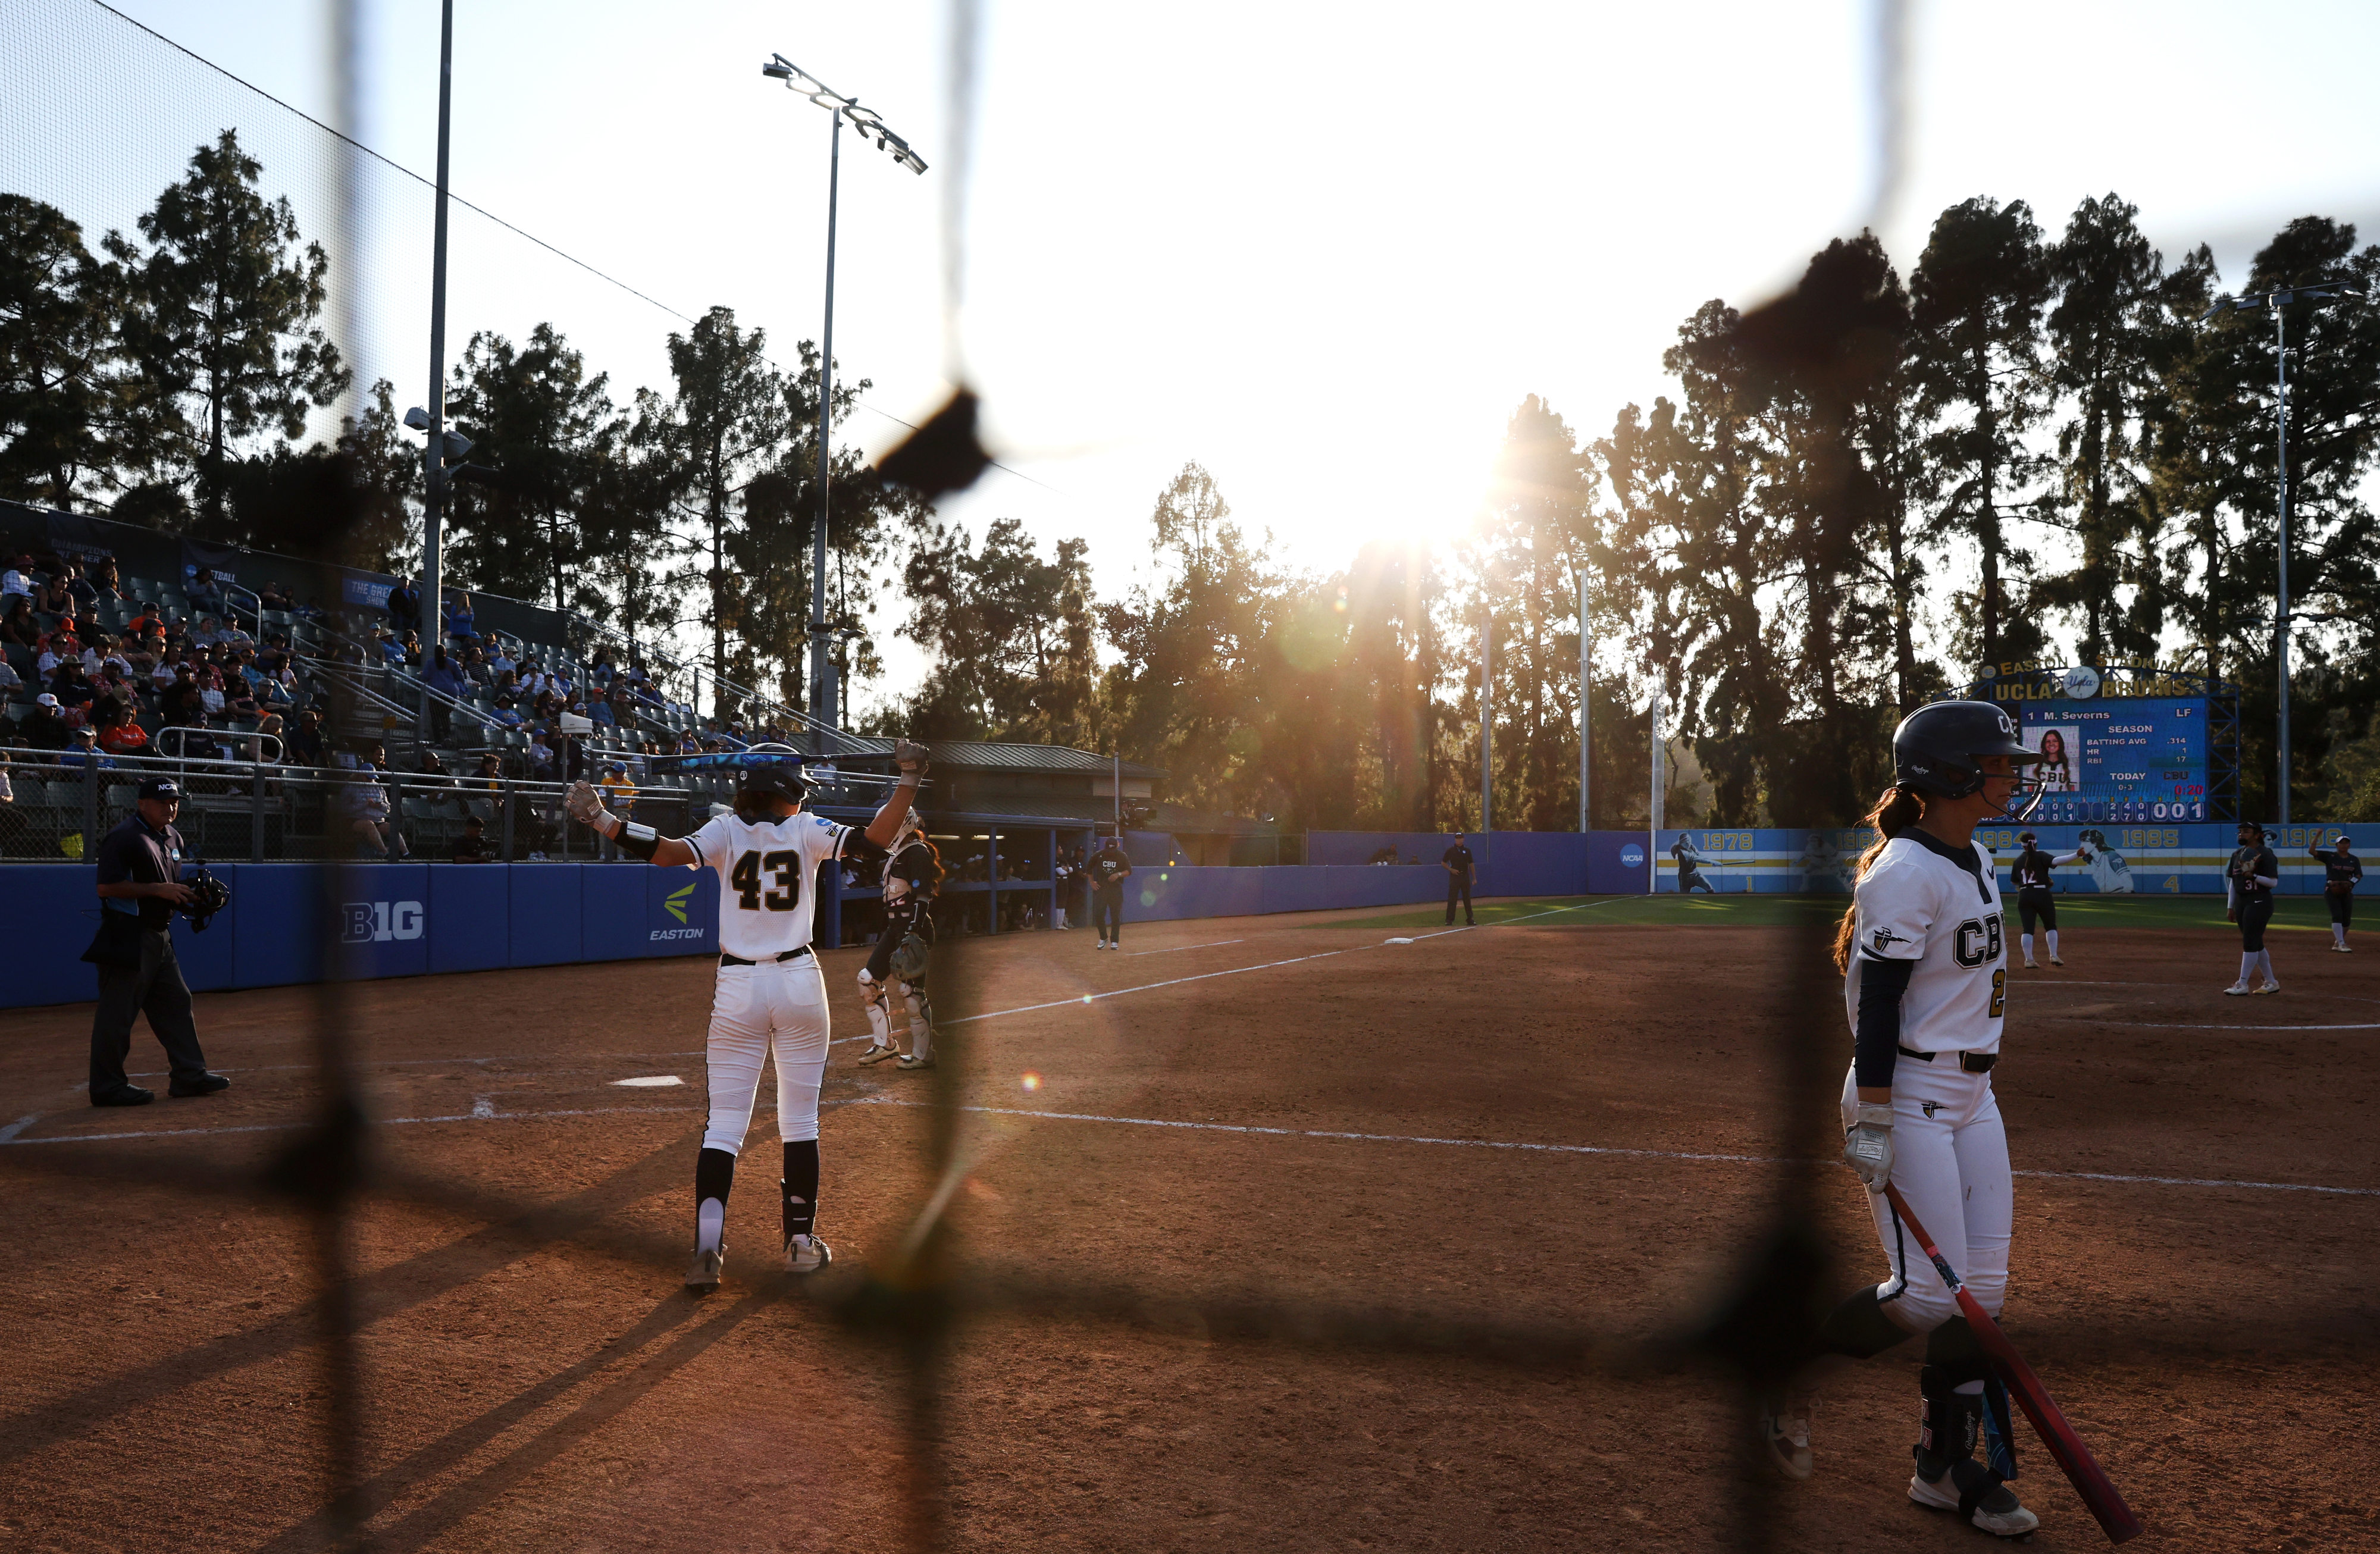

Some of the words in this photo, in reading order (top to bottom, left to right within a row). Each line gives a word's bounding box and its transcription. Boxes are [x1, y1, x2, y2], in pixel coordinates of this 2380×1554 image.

[52, 538, 112, 557] CHAMPIONS
[352, 581, 369, 594] THE
[366, 595, 386, 606] SHOW
[2000, 656, 2068, 676] EASTON
[2095, 654, 2177, 671] STADIUM
[1996, 683, 2052, 700] UCLA
[2102, 679, 2187, 698] BRUINS
[2028, 712, 2034, 720] 1
[2044, 712, 2058, 720] M.
[2062, 712, 2110, 720] Severns
[2176, 709, 2191, 718] LF
[2108, 725, 2153, 734] SEASON
[2163, 771, 2189, 780] CBU
[2174, 785, 2203, 795] 0:20
[2153, 803, 2167, 818] 0
[2171, 803, 2185, 818] 0
[2191, 803, 2202, 817] 1
[1703, 833, 1753, 851] 1978
[1836, 832, 1874, 850] 198
[2122, 829, 2179, 847] 1985
[731, 850, 800, 911] 43
[1746, 876, 1753, 892] 1
[2163, 875, 2179, 892] 4
[2244, 879, 2258, 891] 31
[649, 928, 704, 941] EASTON
[1953, 912, 2003, 970] CB
[1989, 969, 2006, 1019] 2
[1965, 1410, 1976, 1450] Rawlings
